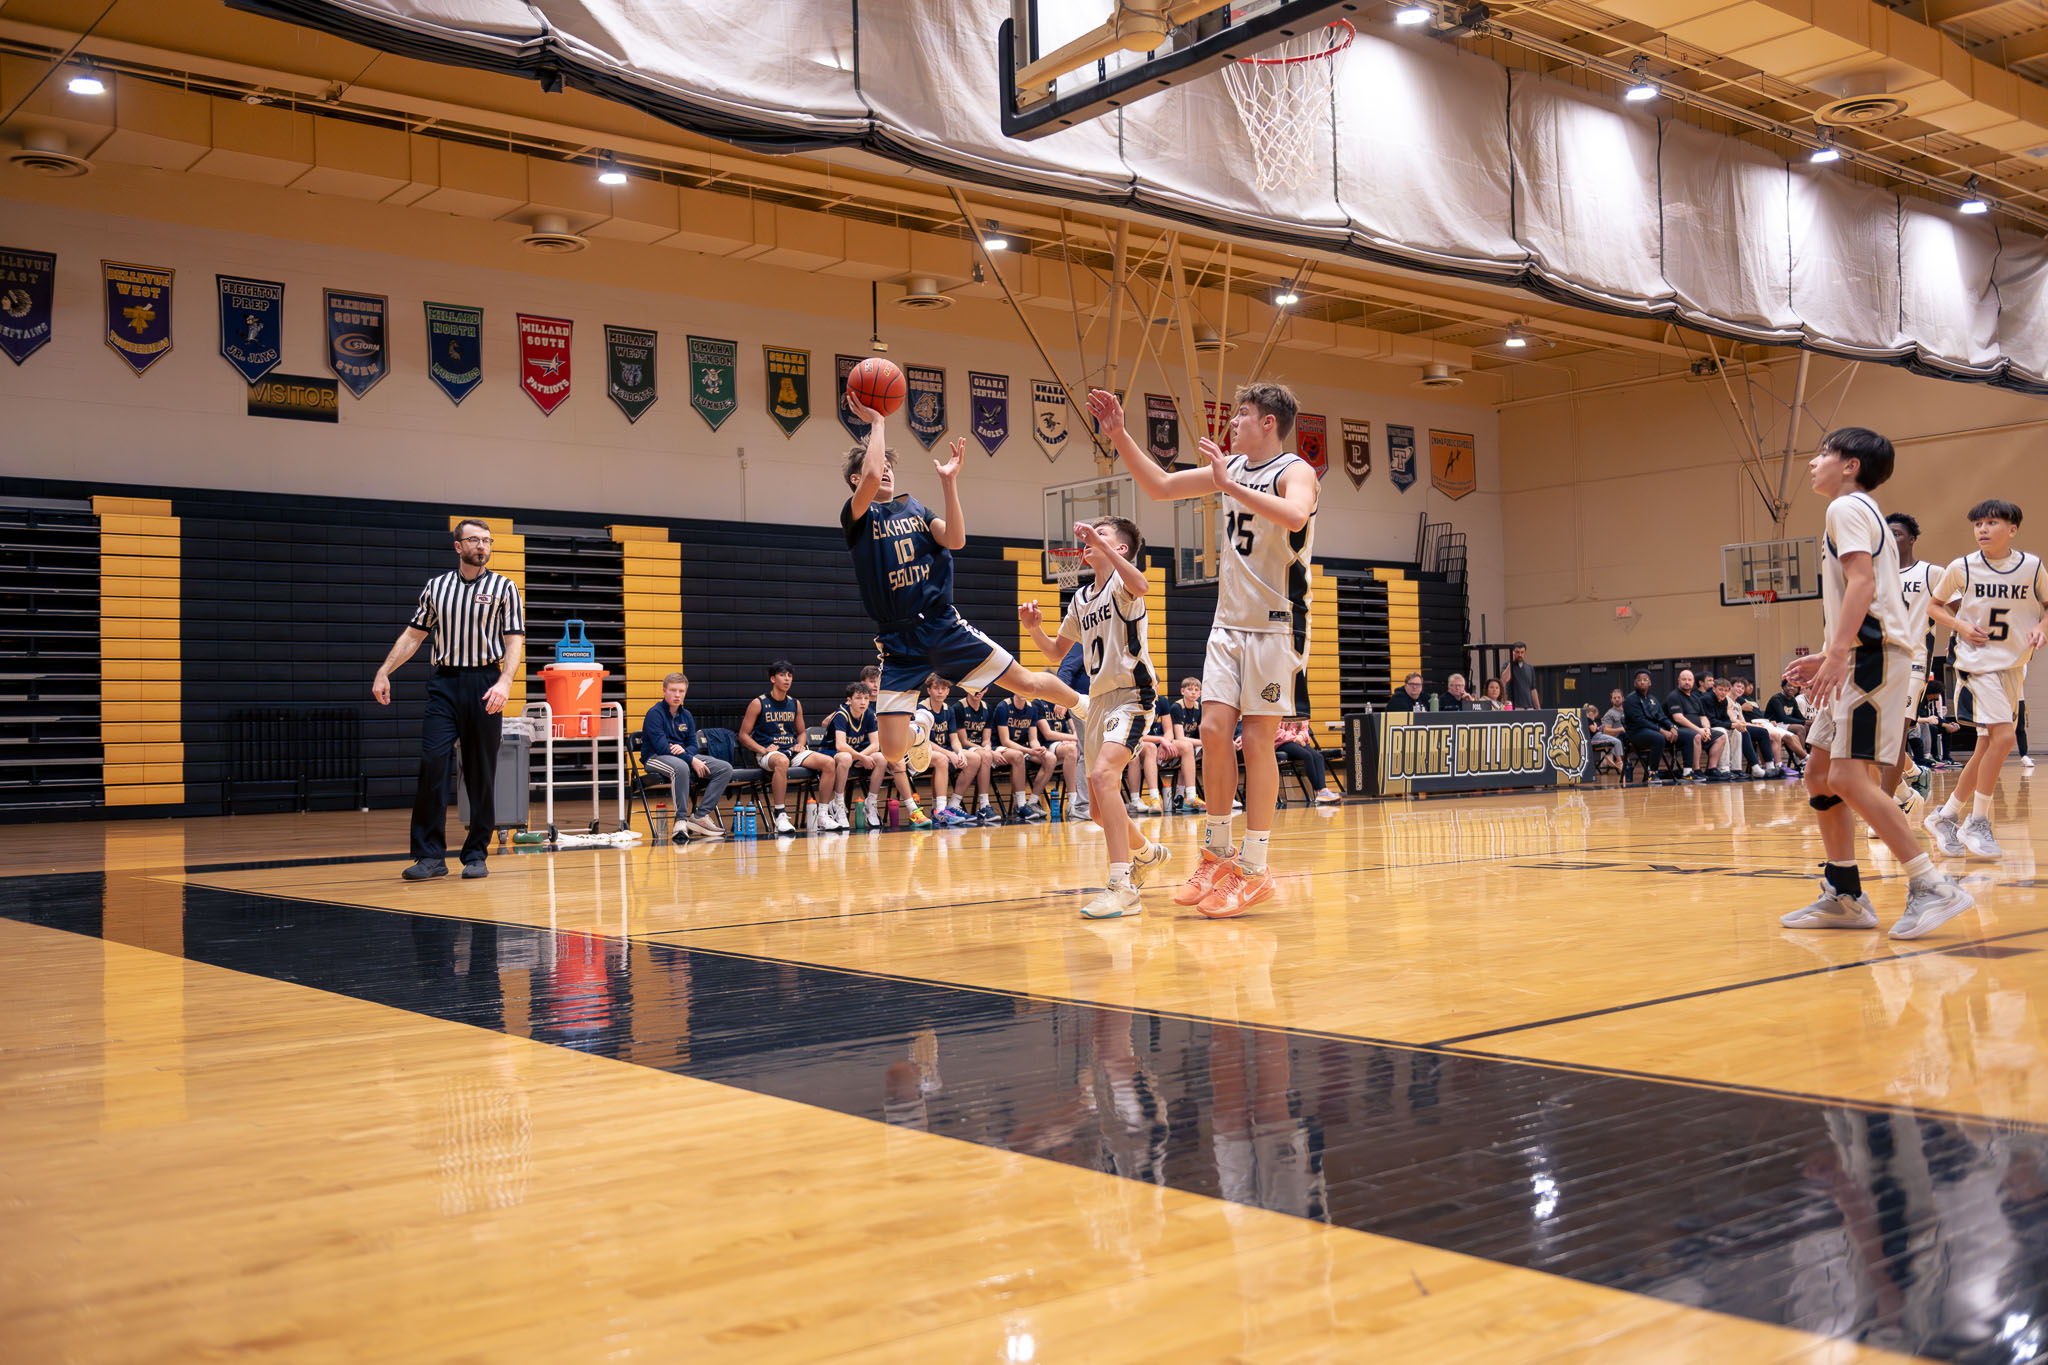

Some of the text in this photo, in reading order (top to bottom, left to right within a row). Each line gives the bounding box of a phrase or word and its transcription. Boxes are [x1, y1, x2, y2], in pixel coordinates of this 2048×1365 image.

[107, 268, 170, 287] BELLEVUE
[116, 282, 161, 299] WEST
[222, 282, 280, 300] CREIGHTON
[232, 296, 270, 311] PREP
[334, 311, 379, 327] SOUTH
[429, 309, 480, 324] MILLARD
[433, 322, 477, 337] NORTH
[521, 322, 570, 337] MILLARD
[353, 341, 380, 351] STORM
[526, 335, 566, 348] SOUTH
[608, 333, 655, 348] MILLARD
[692, 341, 732, 355] OMAHA
[247, 348, 278, 364] JAYS
[615, 345, 649, 360] WEST
[691, 352, 734, 367] BENSON
[769, 351, 806, 365] OMAHA
[335, 359, 379, 376] STORM
[432, 361, 481, 384] MUSTANGS
[769, 362, 806, 376] BRYAN
[526, 376, 570, 394] PATRIOTS
[973, 377, 1005, 389] OMAHA
[1036, 384, 1065, 396] OMAHA
[253, 383, 338, 408] VISITOR
[972, 388, 1008, 400] CENTRAL
[774, 404, 803, 418] BEARS
[977, 425, 1005, 438] EAGLES
[872, 515, 929, 540] ELKHORN
[1225, 510, 1254, 557] 15
[894, 537, 915, 565] 10
[888, 563, 930, 591] SOUTH
[1974, 583, 2029, 600] BURKE
[1082, 603, 1112, 631] URKE
[1987, 607, 2011, 642] 5
[765, 711, 795, 722] ELKHORN
[777, 723, 787, 735] 3
[1389, 722, 1546, 779] BURKE BULLDOGS
